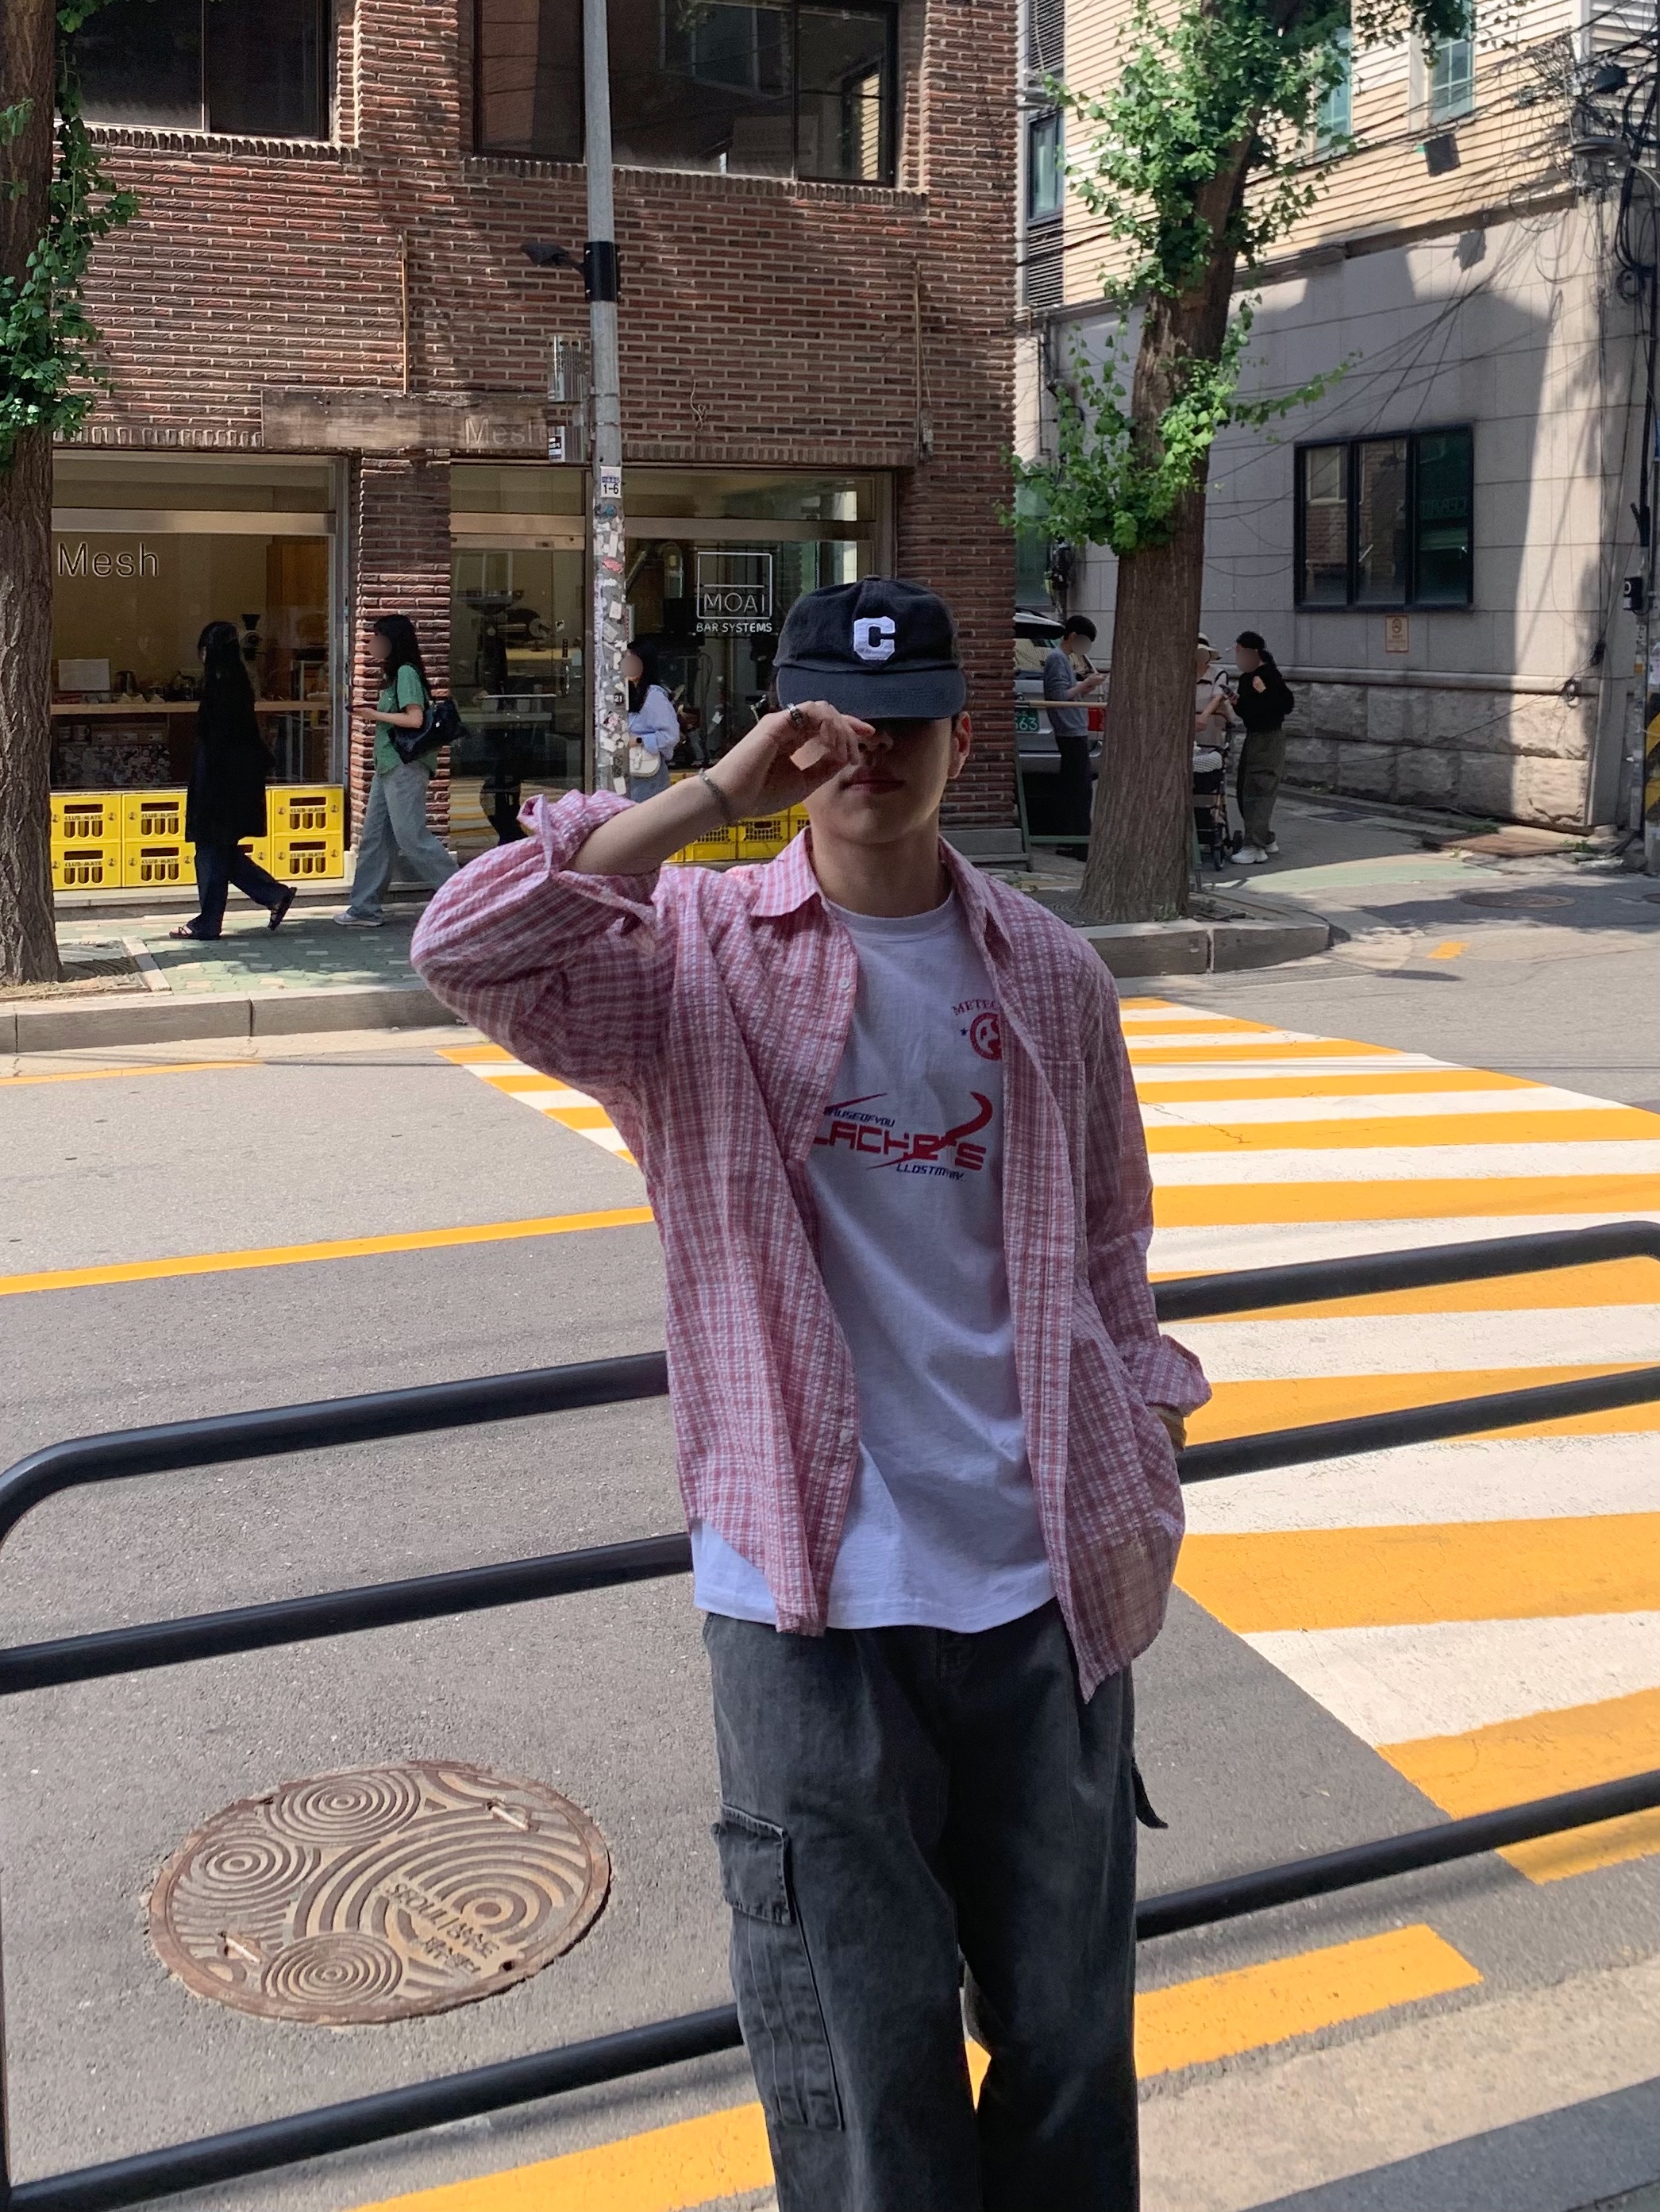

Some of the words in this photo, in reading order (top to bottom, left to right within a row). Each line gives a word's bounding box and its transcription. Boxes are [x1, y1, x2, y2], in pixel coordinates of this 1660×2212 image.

[603, 483, 619, 495] 1-6
[58, 542, 159, 577] Mesh
[703, 592, 765, 613] MOAI
[696, 622, 719, 633] BAR
[721, 622, 773, 633] SYSTEMS
[853, 616, 895, 660] C
